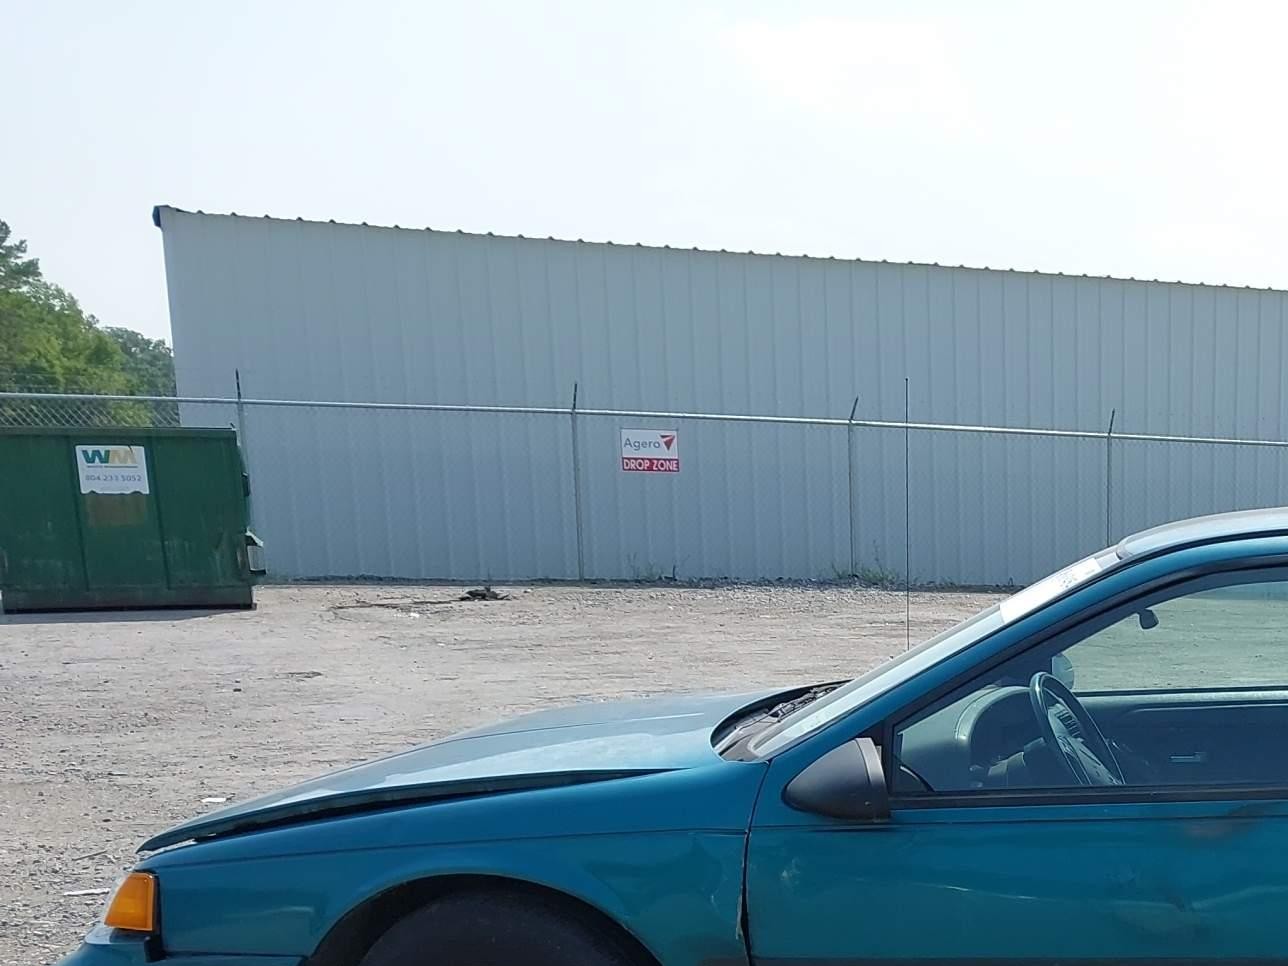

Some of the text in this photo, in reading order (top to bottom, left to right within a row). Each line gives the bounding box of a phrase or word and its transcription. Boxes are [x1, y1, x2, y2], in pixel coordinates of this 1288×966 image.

[624, 438, 660, 451] Agero
[82, 449, 137, 464] WM
[623, 458, 679, 471] DROP ZONE
